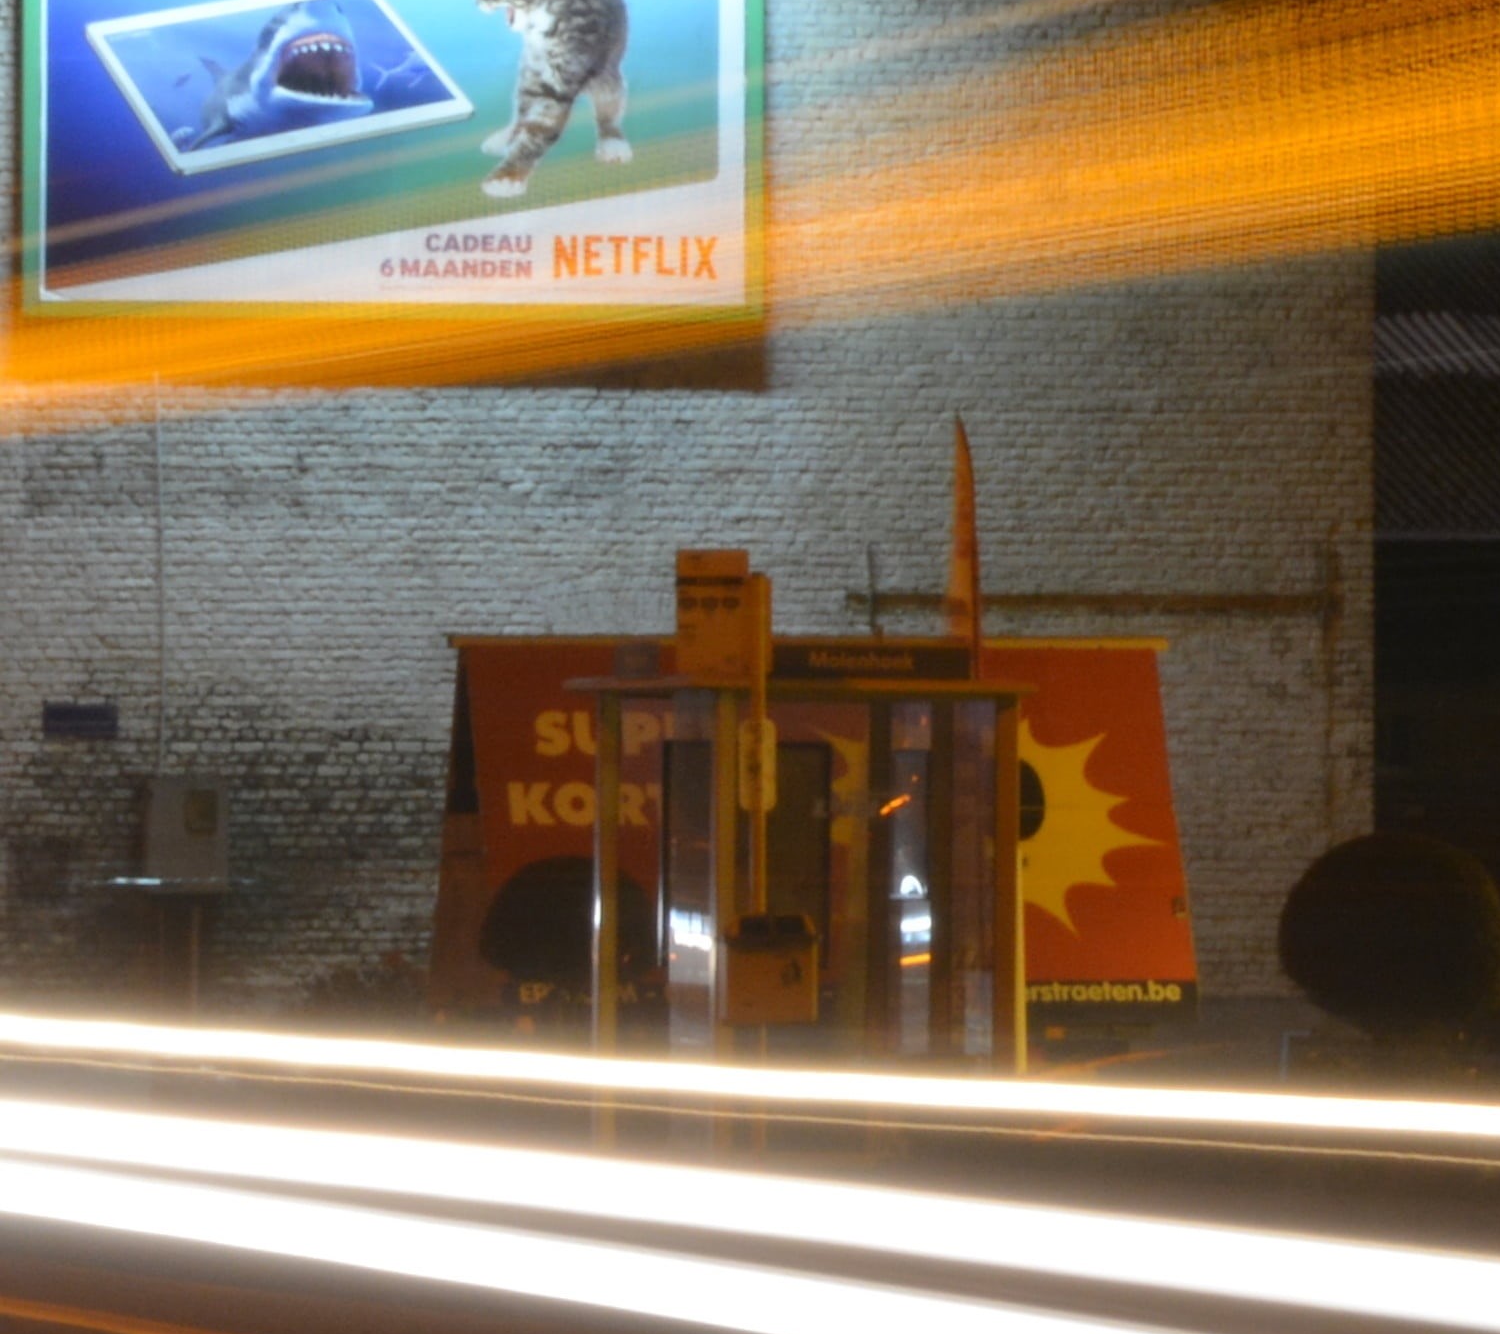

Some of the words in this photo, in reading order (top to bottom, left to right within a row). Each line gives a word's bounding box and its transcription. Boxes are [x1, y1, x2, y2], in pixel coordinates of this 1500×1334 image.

[425, 233, 533, 254] CADEAU
[553, 234, 718, 280] NETFLIX
[380, 259, 394, 278] 6
[398, 259, 533, 279] MAANDEN
